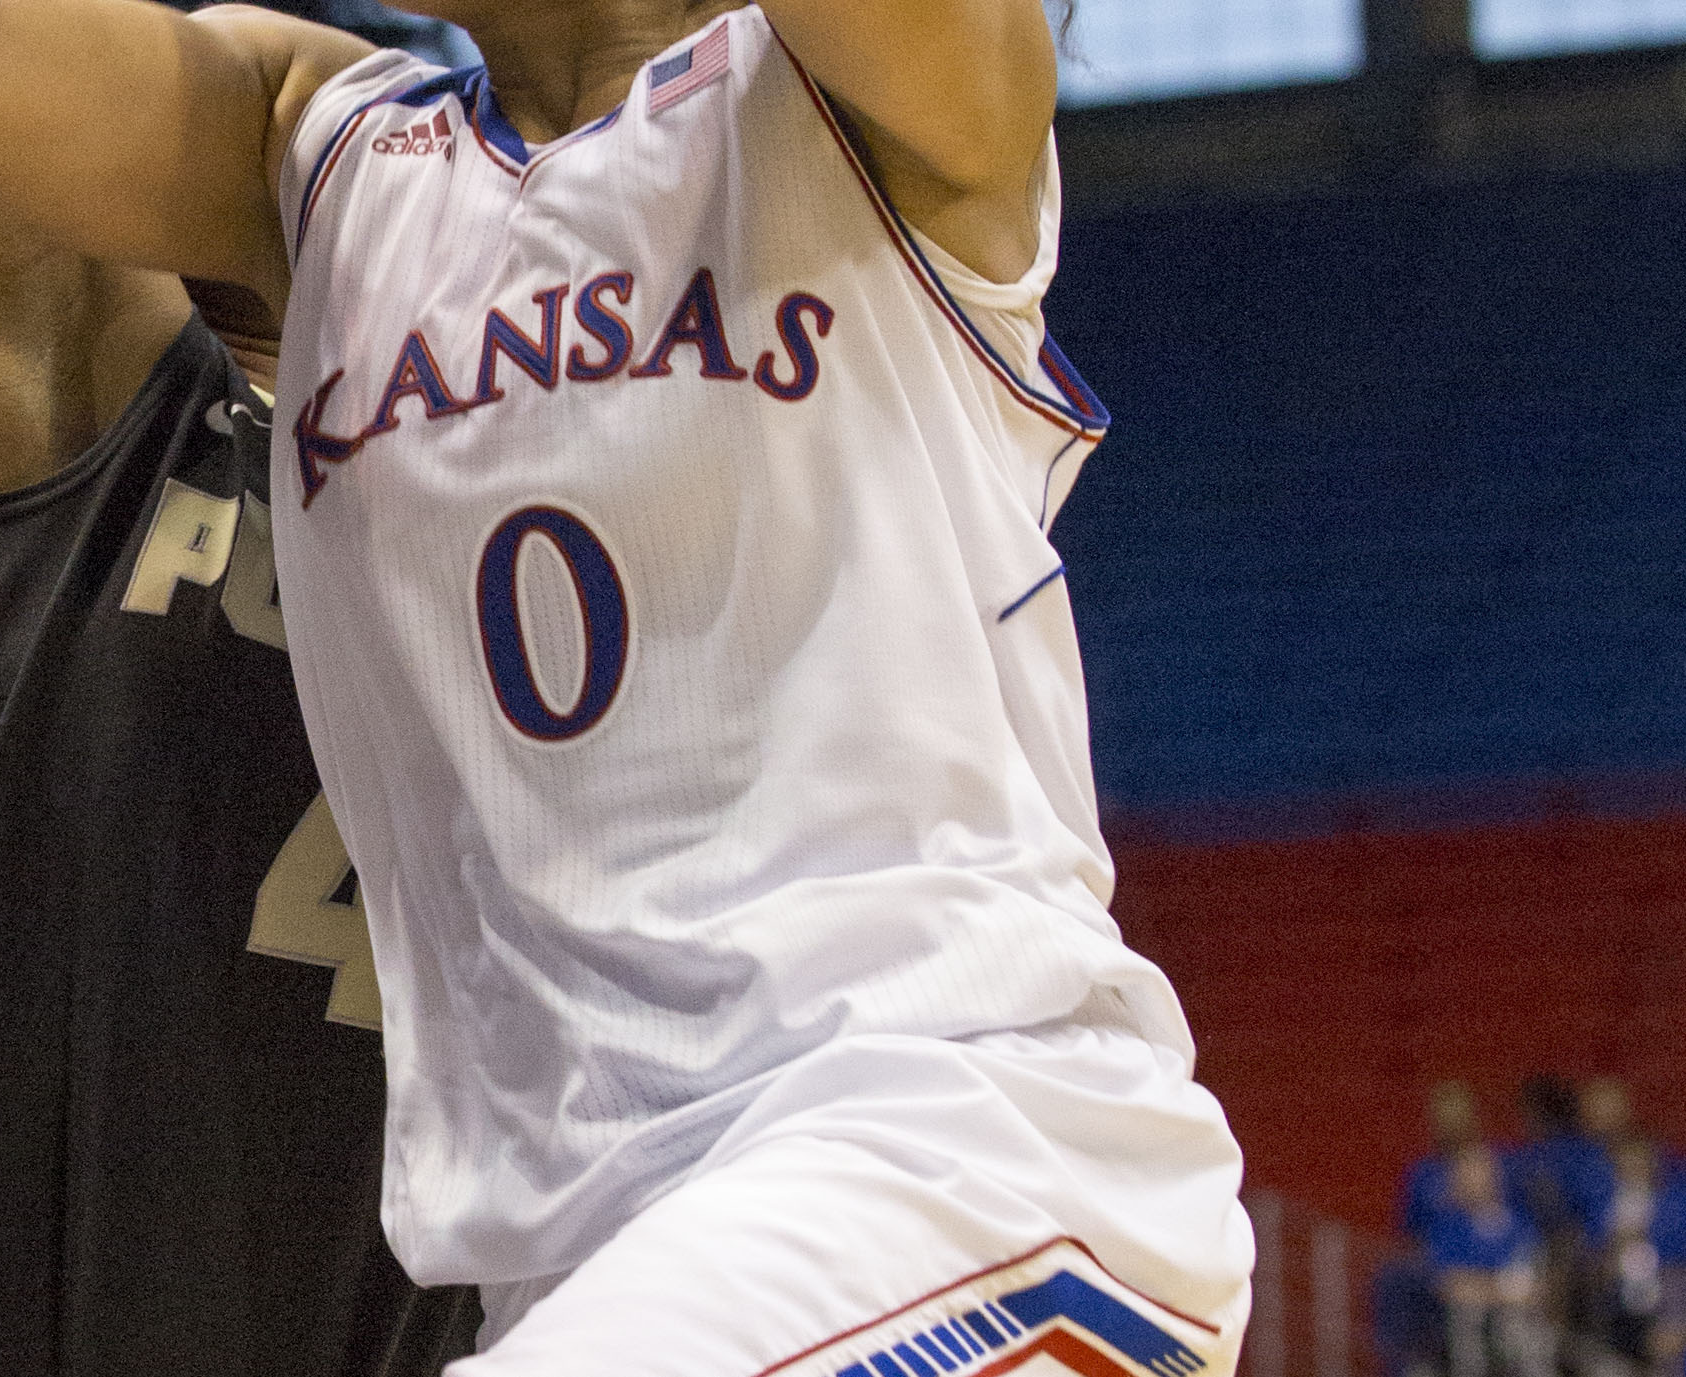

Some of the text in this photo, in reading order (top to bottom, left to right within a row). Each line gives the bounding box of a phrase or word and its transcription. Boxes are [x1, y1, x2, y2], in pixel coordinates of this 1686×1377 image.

[293, 267, 834, 511] KANSAS
[476, 504, 631, 741] 0
[245, 787, 383, 1032] 4
